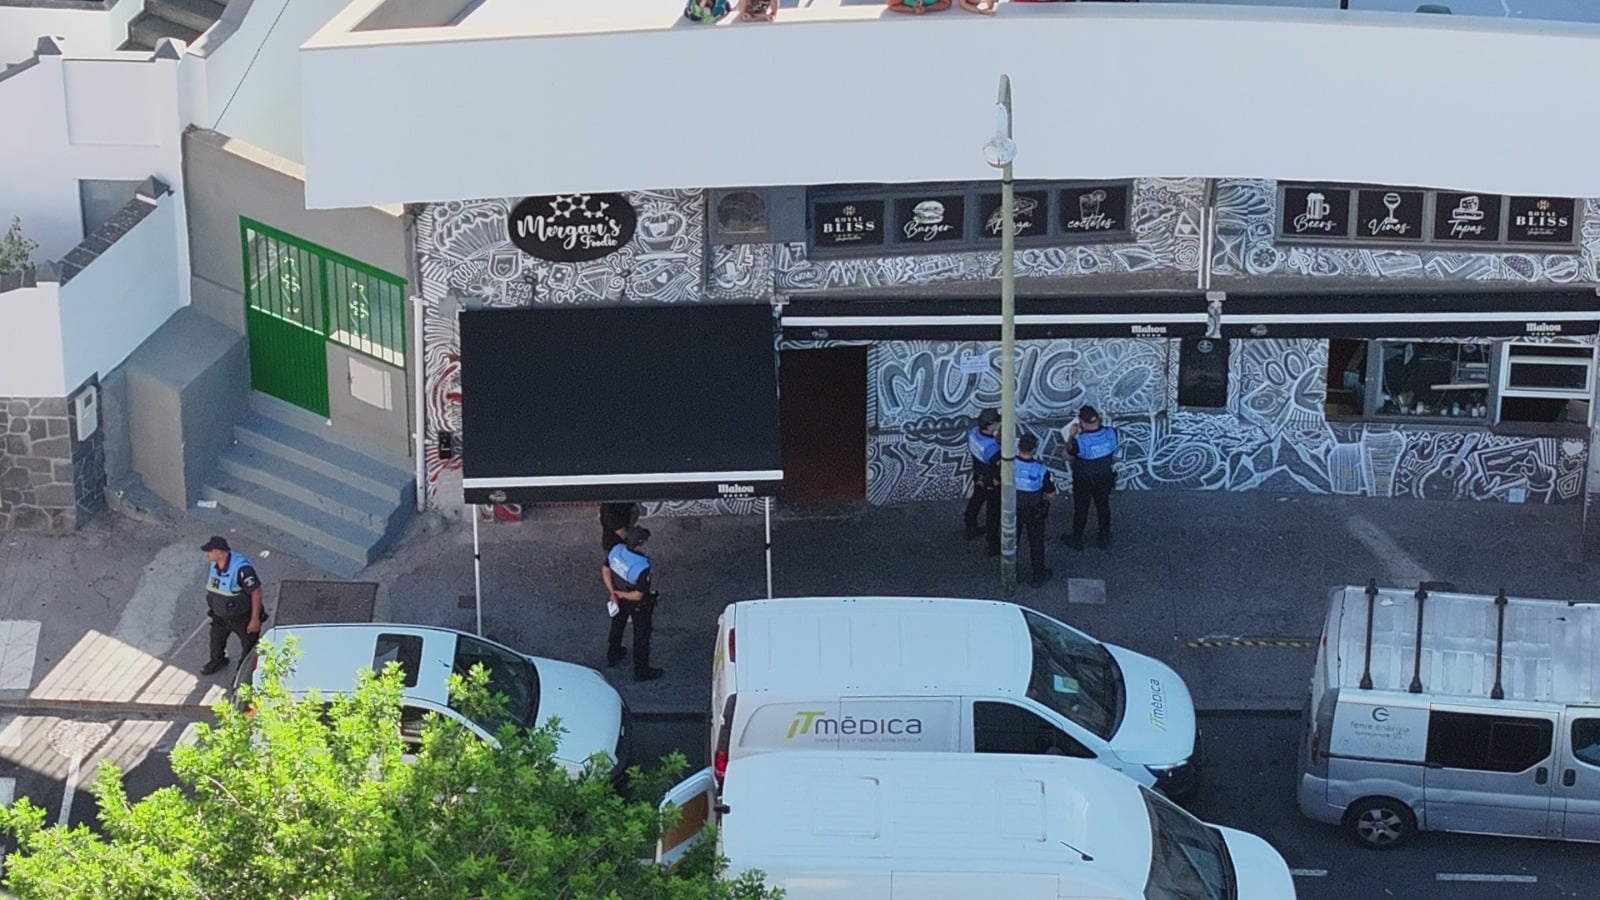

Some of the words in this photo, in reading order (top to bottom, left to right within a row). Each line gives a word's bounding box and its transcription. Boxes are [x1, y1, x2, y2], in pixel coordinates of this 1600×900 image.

[823, 220, 876, 233] BLISS
[1293, 213, 1337, 232] Beers
[1368, 218, 1411, 235] Vinos
[1447, 219, 1487, 239] Tapas
[1515, 216, 1569, 227] BLISS
[517, 215, 621, 250] Morgan's
[903, 220, 954, 241] Burger
[580, 233, 619, 249] Foodie
[1131, 324, 1167, 334] Mahou
[1526, 322, 1562, 332] Mahou
[879, 346, 1086, 414] MUSIC
[718, 483, 755, 494] Mahou
